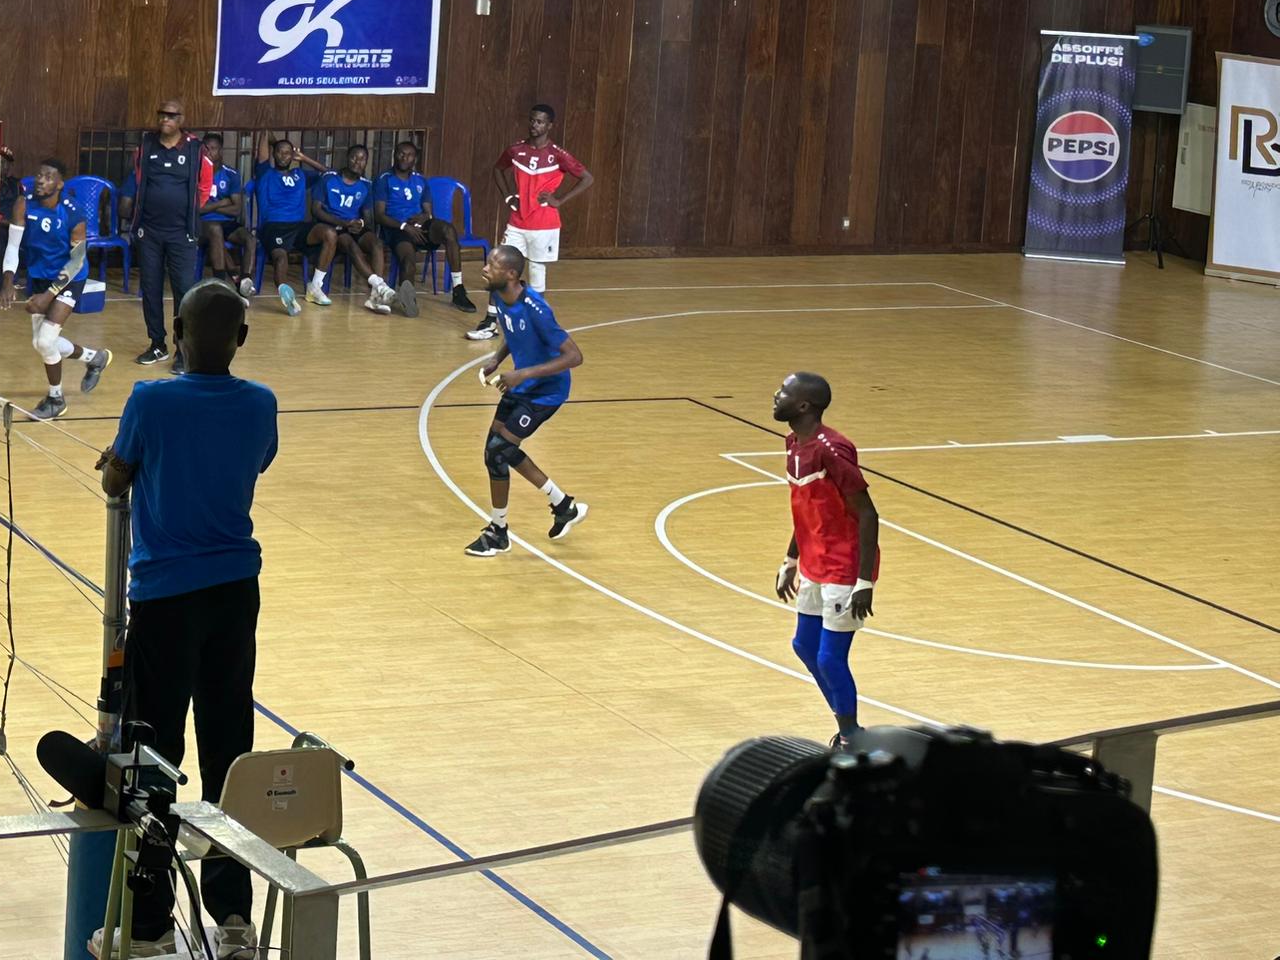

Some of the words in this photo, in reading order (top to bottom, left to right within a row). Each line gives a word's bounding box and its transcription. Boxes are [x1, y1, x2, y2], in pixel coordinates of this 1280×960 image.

[322, 48, 393, 63] SPORTS
[1052, 43, 1124, 56] ASSOIFFÉ
[1051, 53, 1072, 64] DE
[316, 76, 371, 85] SEULEMENT
[1047, 137, 1115, 157] PEPSI
[529, 156, 539, 170] 5
[41, 218, 52, 232] 6
